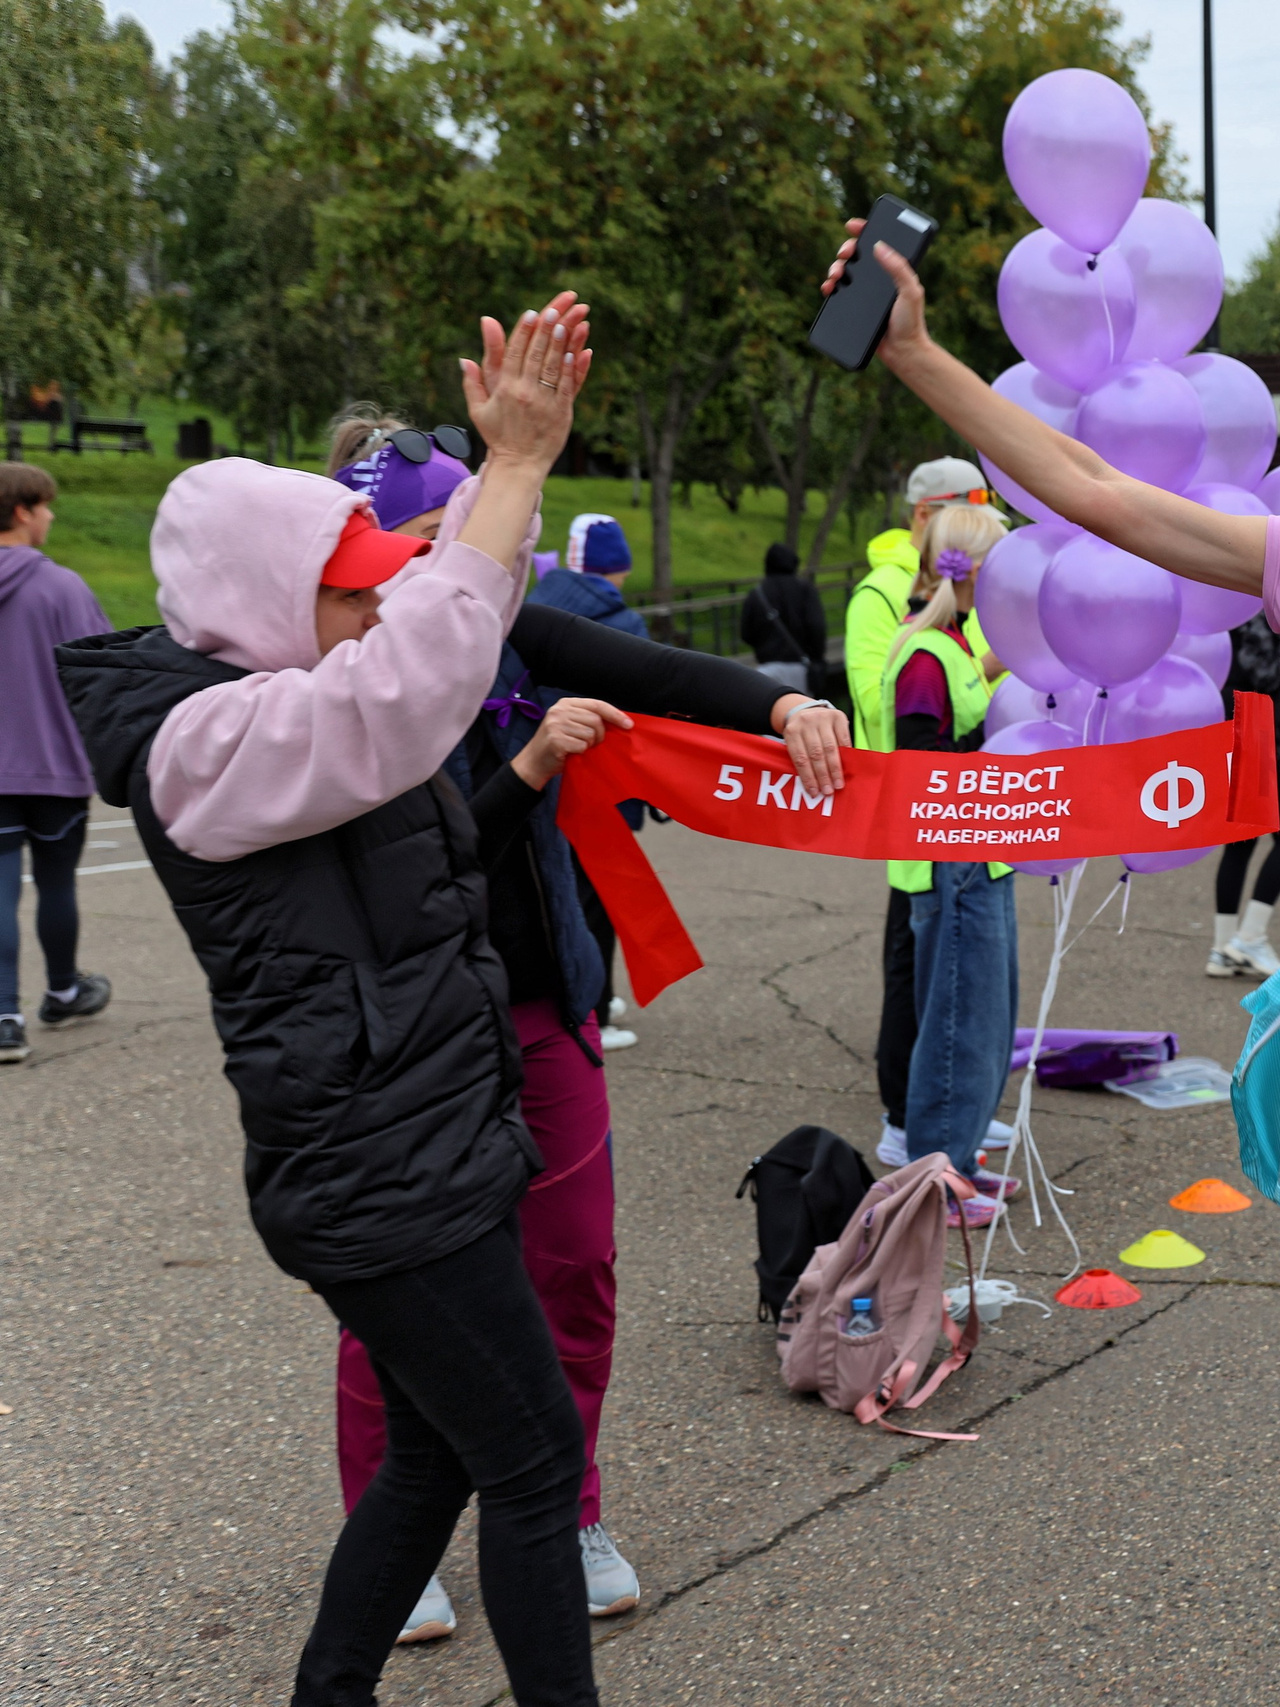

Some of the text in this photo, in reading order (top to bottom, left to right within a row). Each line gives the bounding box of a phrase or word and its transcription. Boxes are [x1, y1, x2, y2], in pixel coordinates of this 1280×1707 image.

[713, 764, 744, 801] 5
[926, 764, 1065, 795] 5 ВЁРСТ
[1140, 751, 1234, 829] Ф
[910, 799, 1071, 821] КРАСНОЯРСК
[917, 827, 1060, 845] НАБЕРЕЖНАЯ
